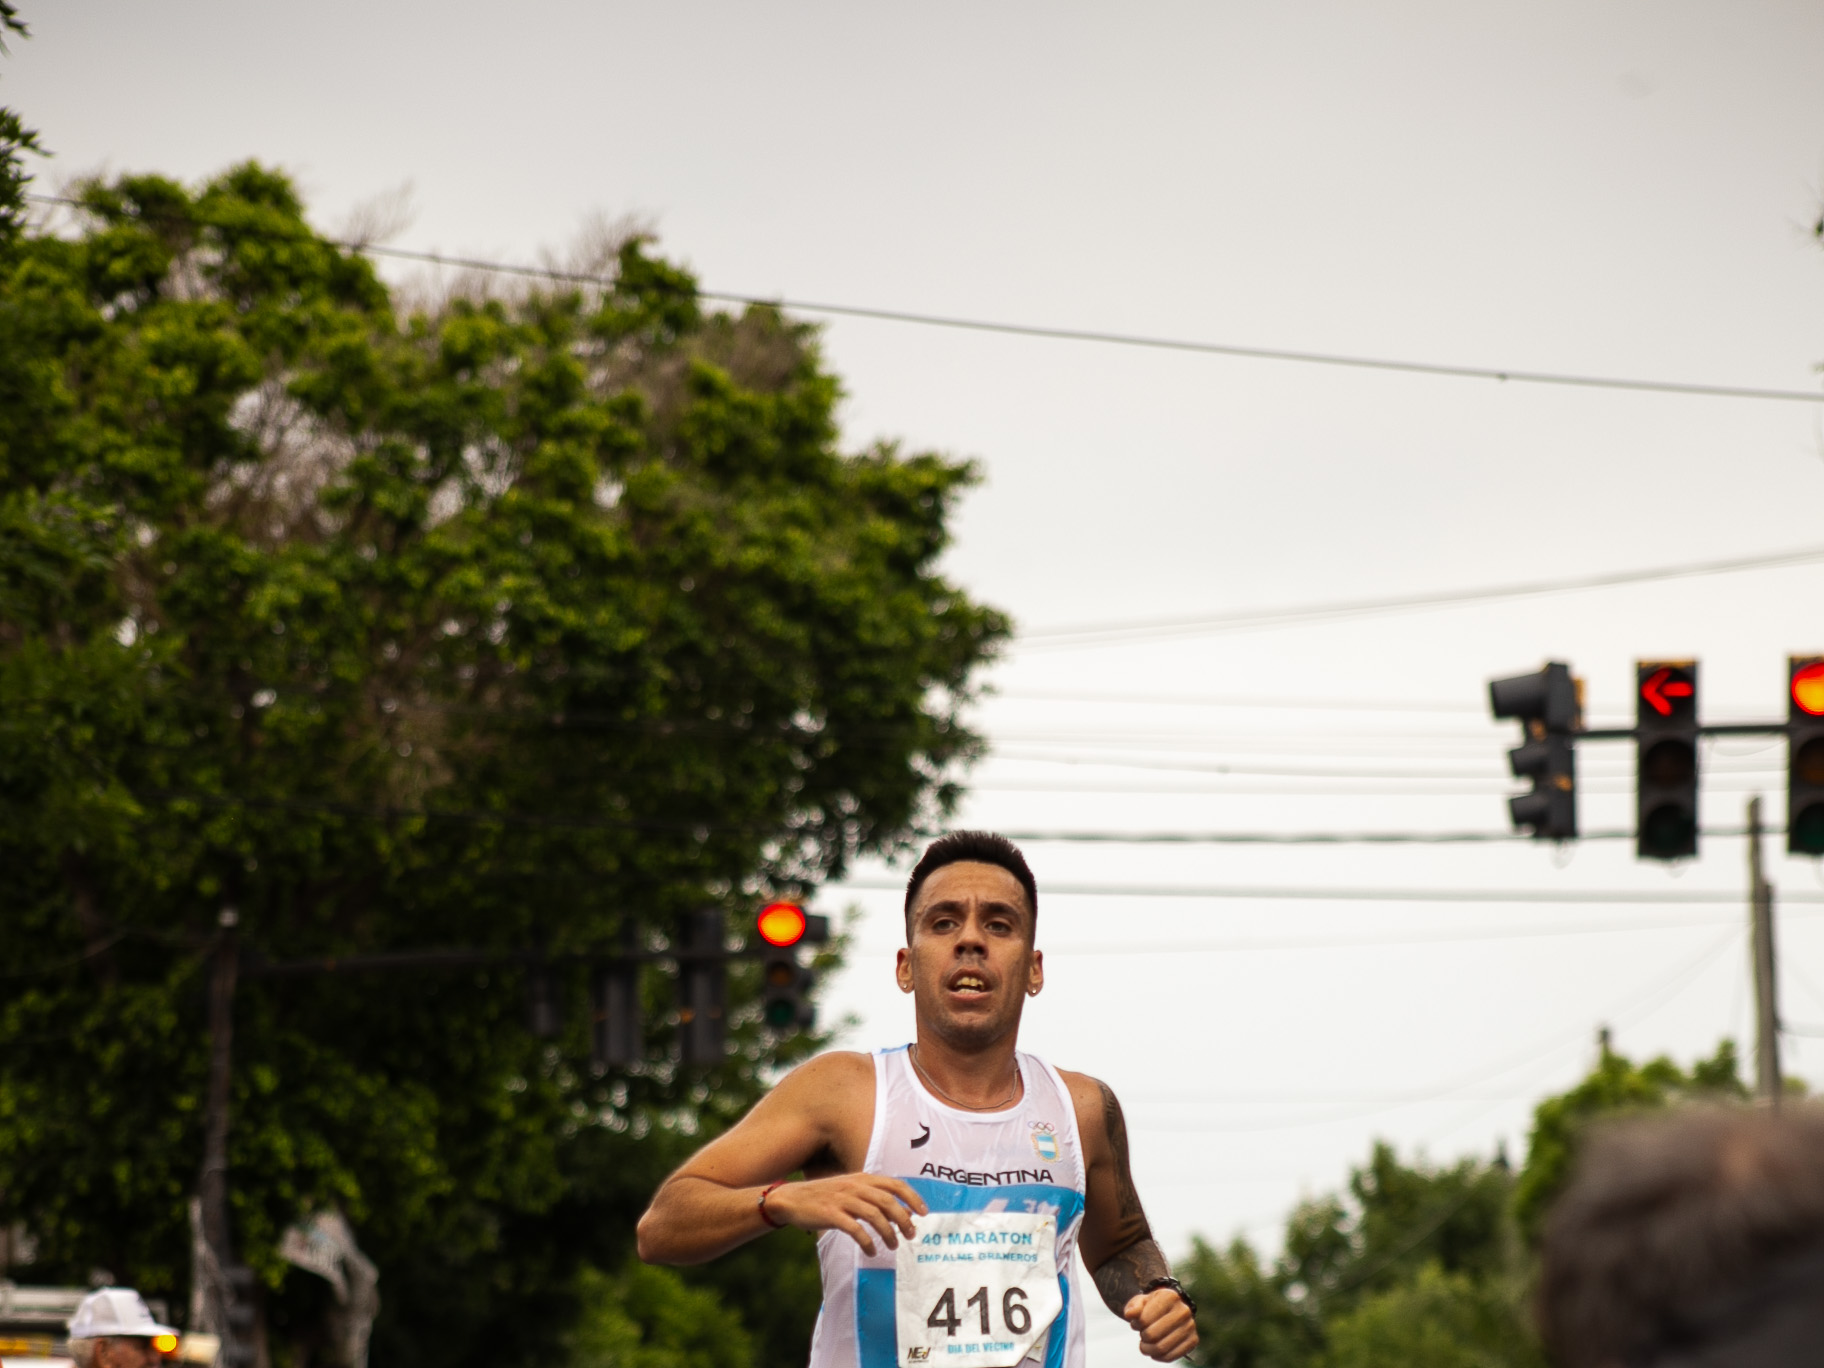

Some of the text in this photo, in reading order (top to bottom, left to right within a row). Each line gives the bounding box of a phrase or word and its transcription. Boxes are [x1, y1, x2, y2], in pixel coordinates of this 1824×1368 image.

[920, 1162, 1054, 1185] ARGENTINA
[922, 1231, 1033, 1246] 40 MARATON
[917, 1252, 1038, 1263] EMPALME GRANEROS
[927, 1286, 1032, 1337] 416
[965, 1342, 981, 1354] DEL
